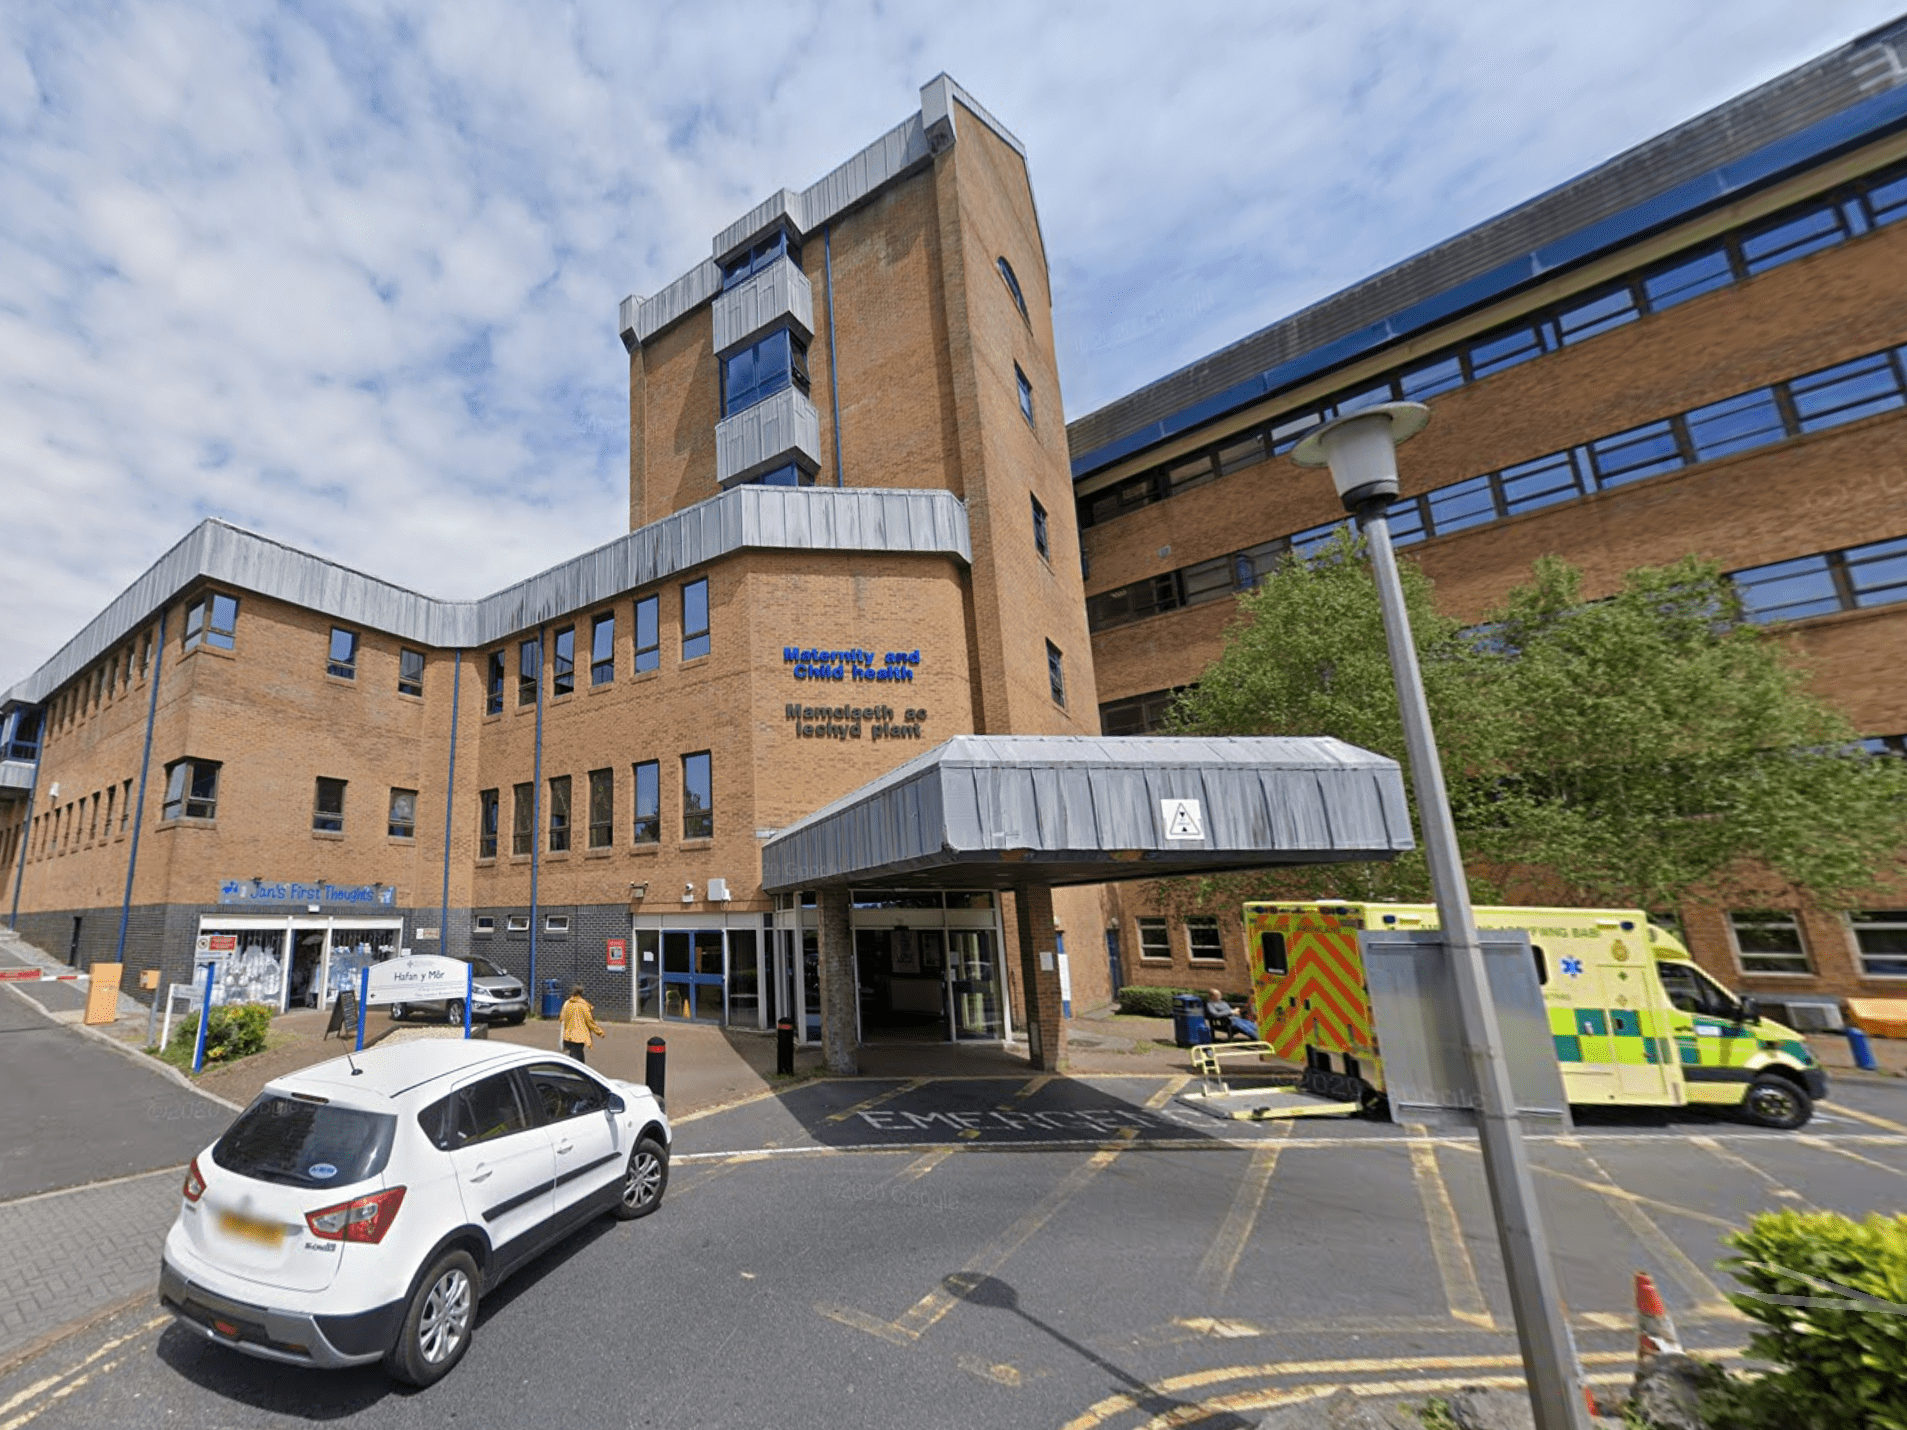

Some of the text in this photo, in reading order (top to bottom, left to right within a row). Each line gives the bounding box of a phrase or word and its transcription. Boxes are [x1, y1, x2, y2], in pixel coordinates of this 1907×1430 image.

[783, 647, 921, 665] Maternity and
[793, 663, 914, 681] Child health
[785, 704, 894, 721] Mamolaeth
[871, 723, 922, 743] plant
[250, 884, 374, 903] Jan's First Thoughts
[394, 972, 419, 981] Hafan
[421, 973, 427, 983] y
